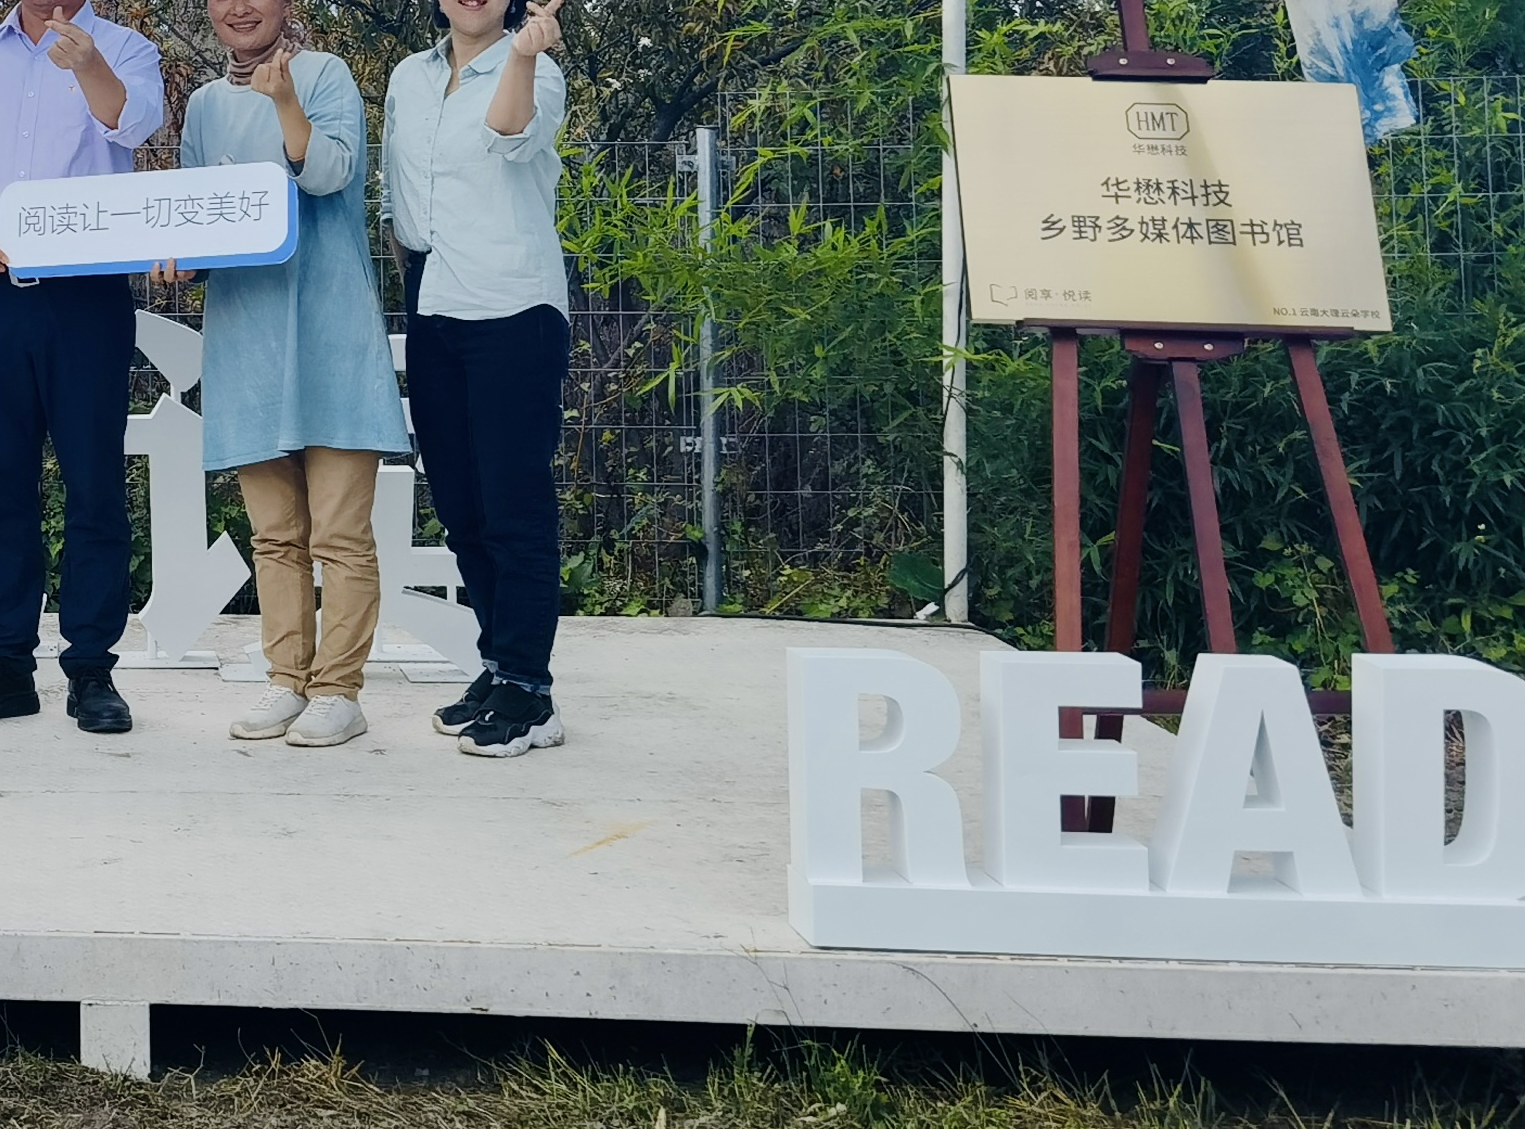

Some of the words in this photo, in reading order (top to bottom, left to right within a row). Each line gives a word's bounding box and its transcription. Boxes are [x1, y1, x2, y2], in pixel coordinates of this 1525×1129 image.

[1135, 110, 1179, 132] HMT
[1132, 142, 1189, 157] 华懋科技
[1100, 176, 1233, 208] 华懋科技
[17, 189, 270, 238] 阅读让一切变美好
[1040, 213, 1305, 248] 乡野多媒体图书馆
[786, 647, 1525, 900] READ
